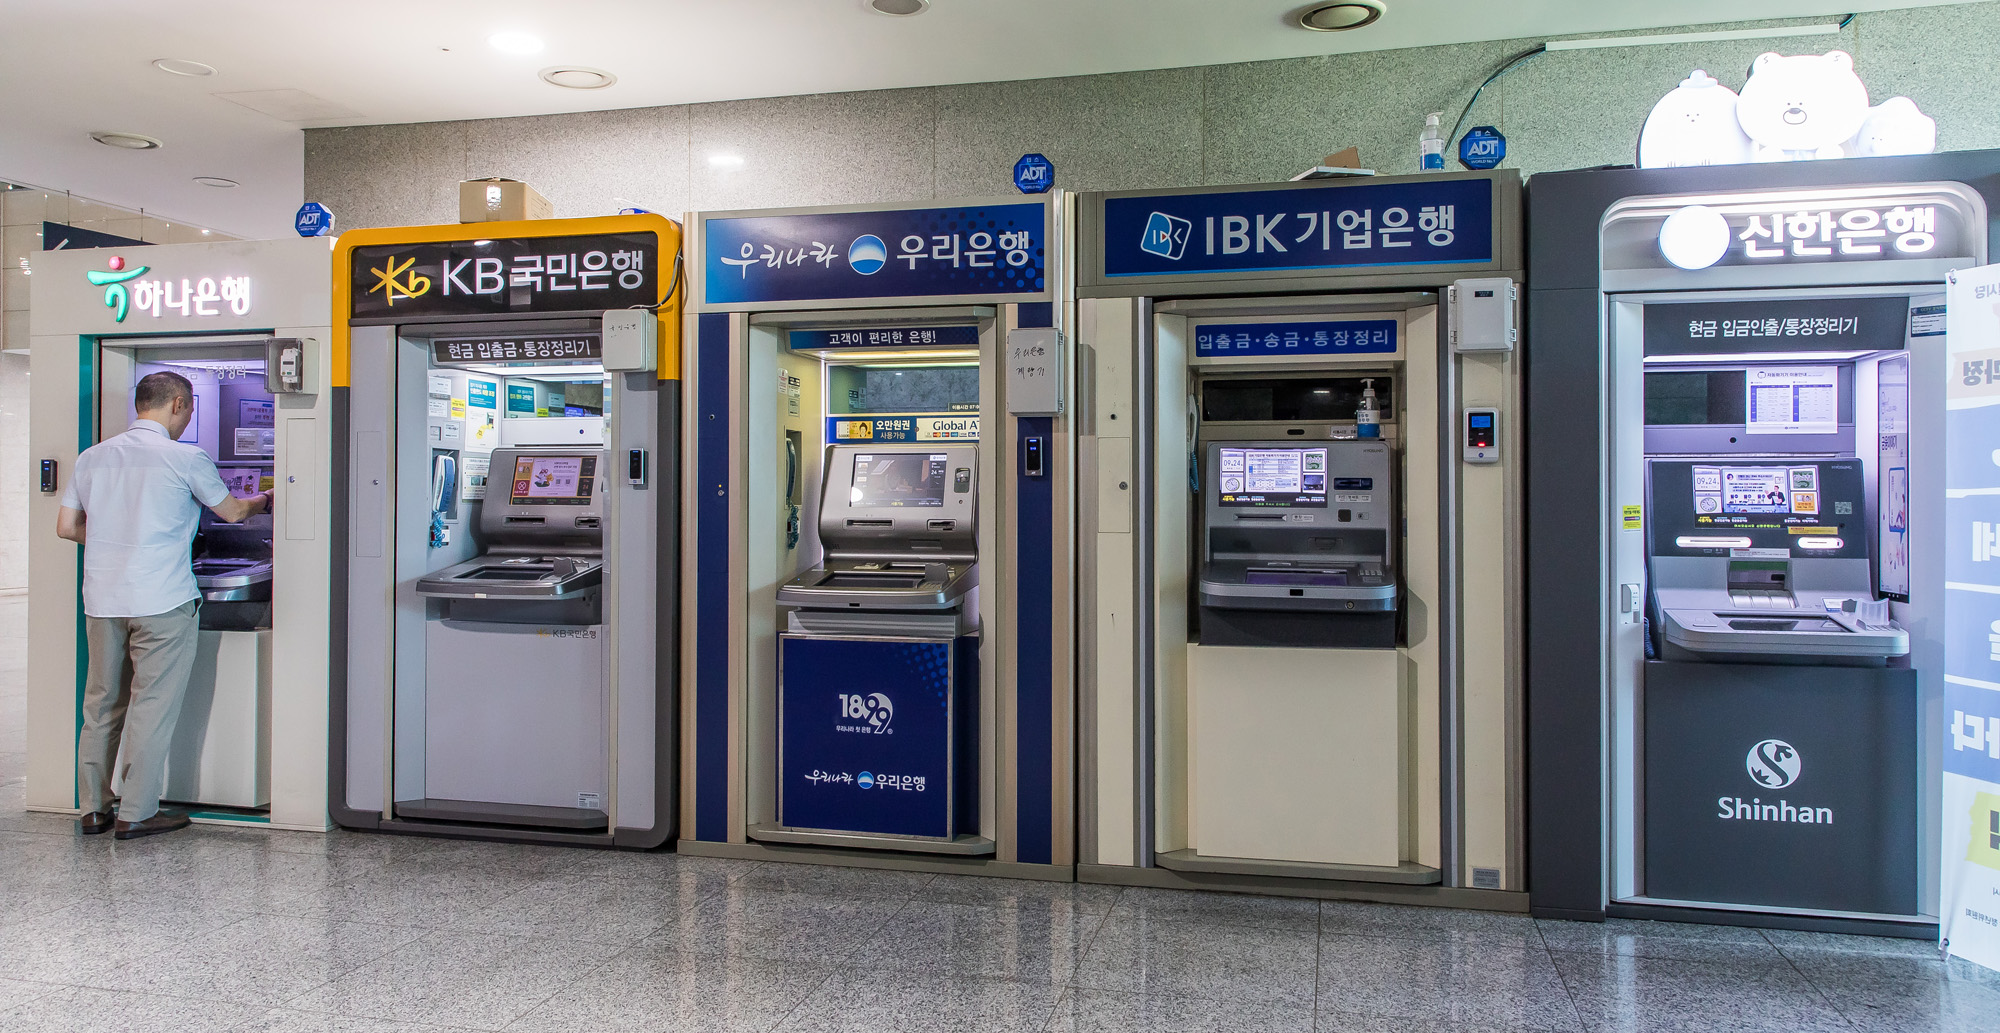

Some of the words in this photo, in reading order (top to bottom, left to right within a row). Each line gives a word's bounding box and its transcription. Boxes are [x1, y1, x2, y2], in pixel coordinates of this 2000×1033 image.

[1468, 140, 1499, 156] ADT
[1020, 166, 1046, 181] ADT
[299, 212, 320, 226] ADT
[1738, 205, 1936, 259] 신한은행
[720, 241, 839, 280] 우리나라
[896, 230, 1031, 270] 우리은행
[134, 275, 251, 318] 하나은행
[1688, 319, 1718, 338] 현금
[1721, 317, 1859, 337] 입금인출/통장정리기
[829, 332, 863, 345] 고객이
[869, 331, 903, 344] 편리한
[909, 330, 937, 343] 은행!
[448, 343, 474, 359] 현금
[875, 420, 910, 431] 오만원권
[933, 420, 967, 431] Global
[880, 431, 905, 440] 사용가능
[839, 692, 894, 735] 1899
[804, 769, 853, 786] 우리나라
[875, 773, 926, 792] 우리은행
[1717, 796, 1833, 825] Shinhan
